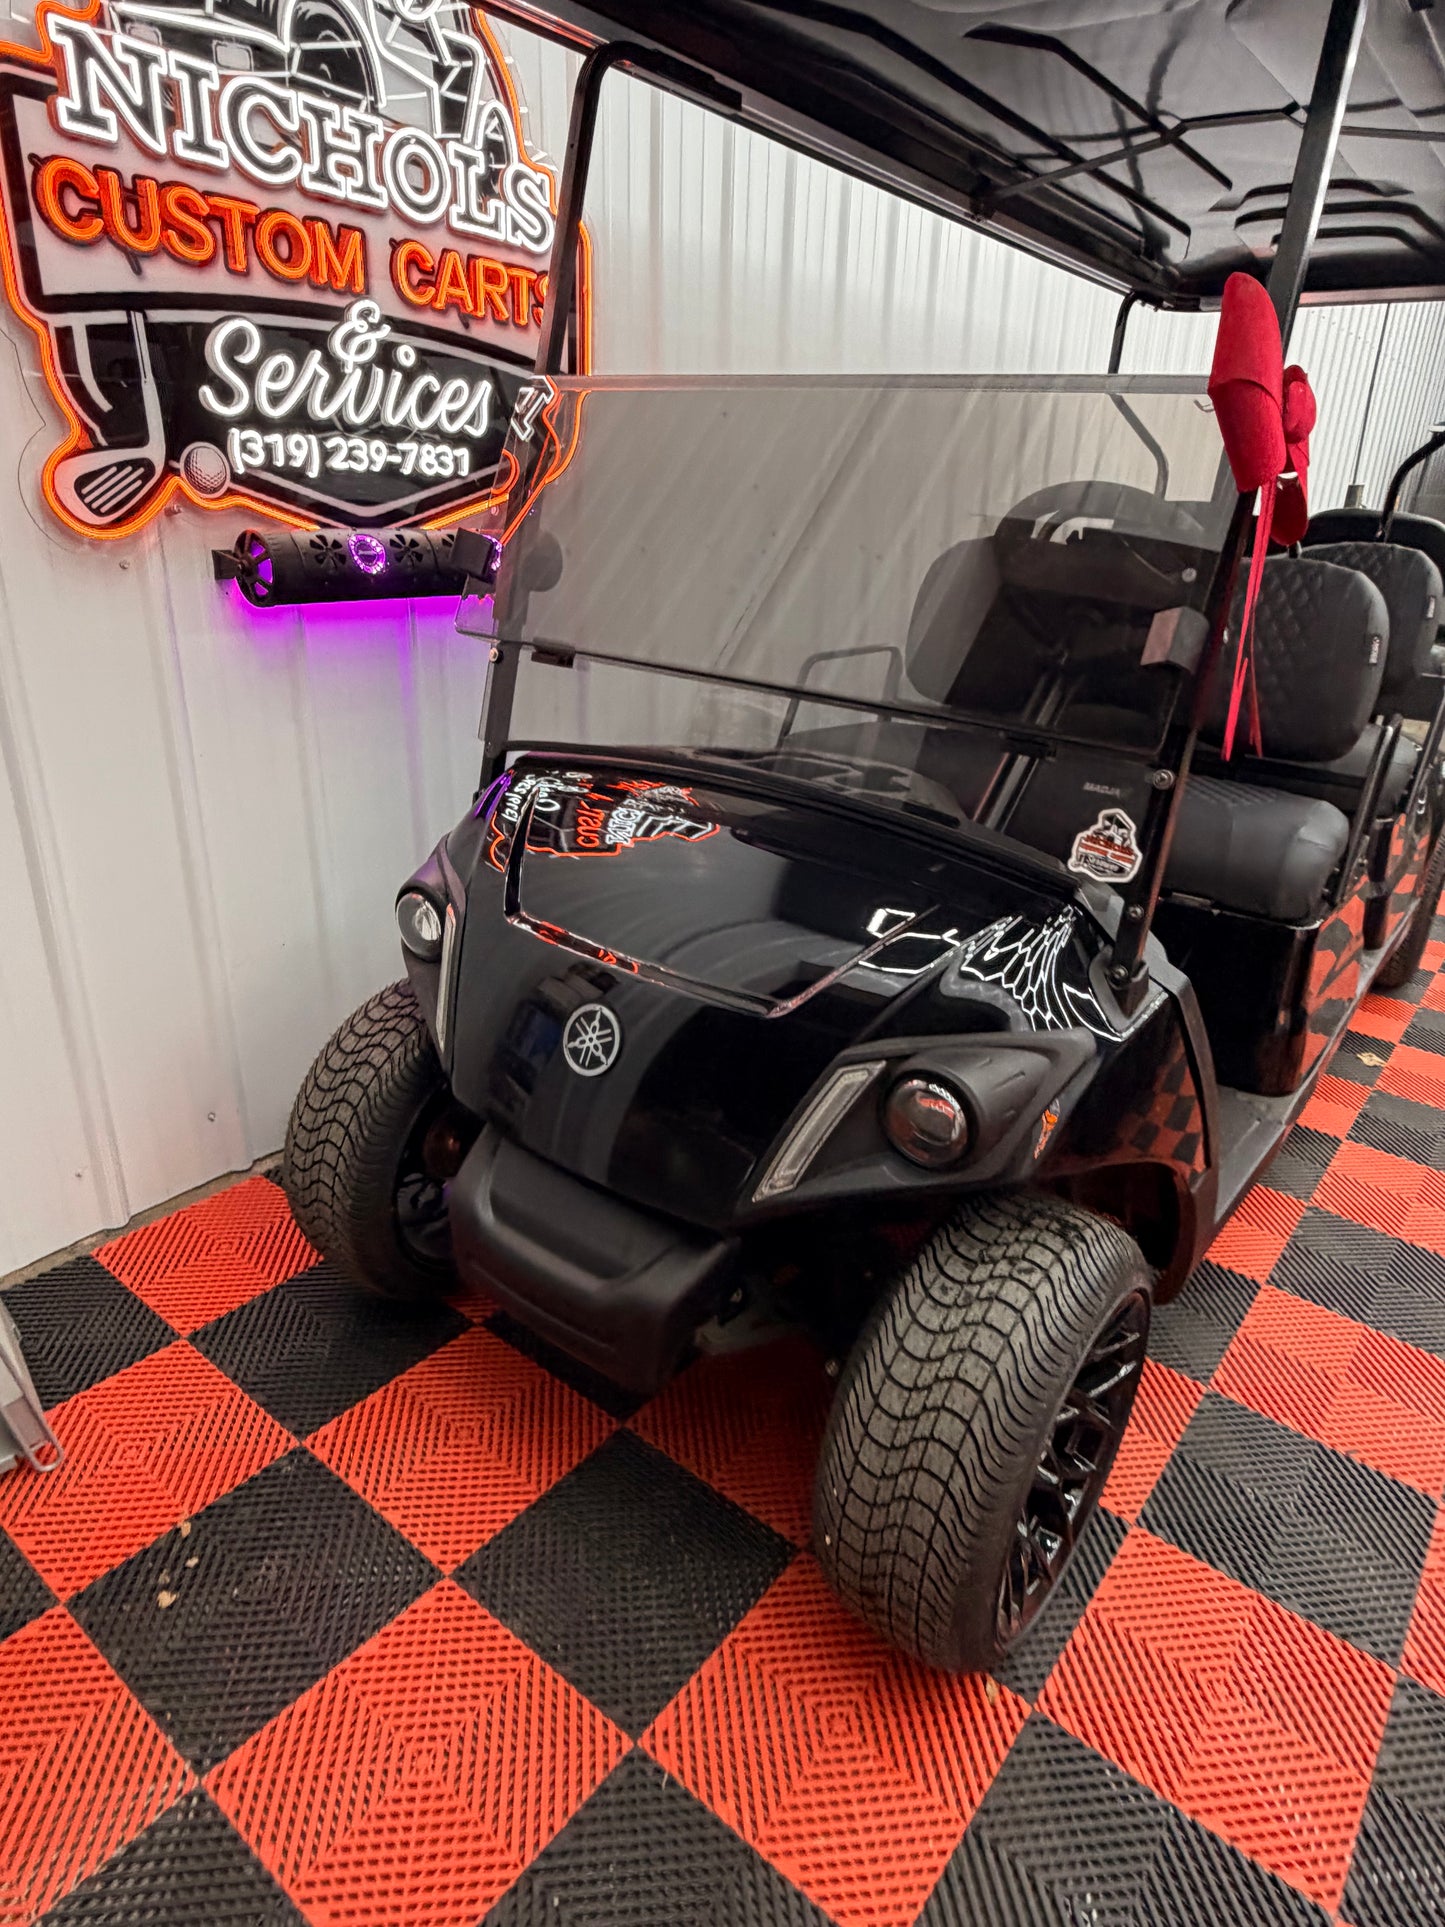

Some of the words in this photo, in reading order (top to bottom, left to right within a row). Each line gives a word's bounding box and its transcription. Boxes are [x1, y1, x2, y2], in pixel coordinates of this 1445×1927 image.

[48, 12, 555, 254] NICHOLS
[34, 156, 367, 294] CUSTOM
[200, 317, 493, 438] Services
[329, 299, 391, 363] &
[228, 428, 319, 478] (319)
[325, 436, 470, 477] 239-7831
